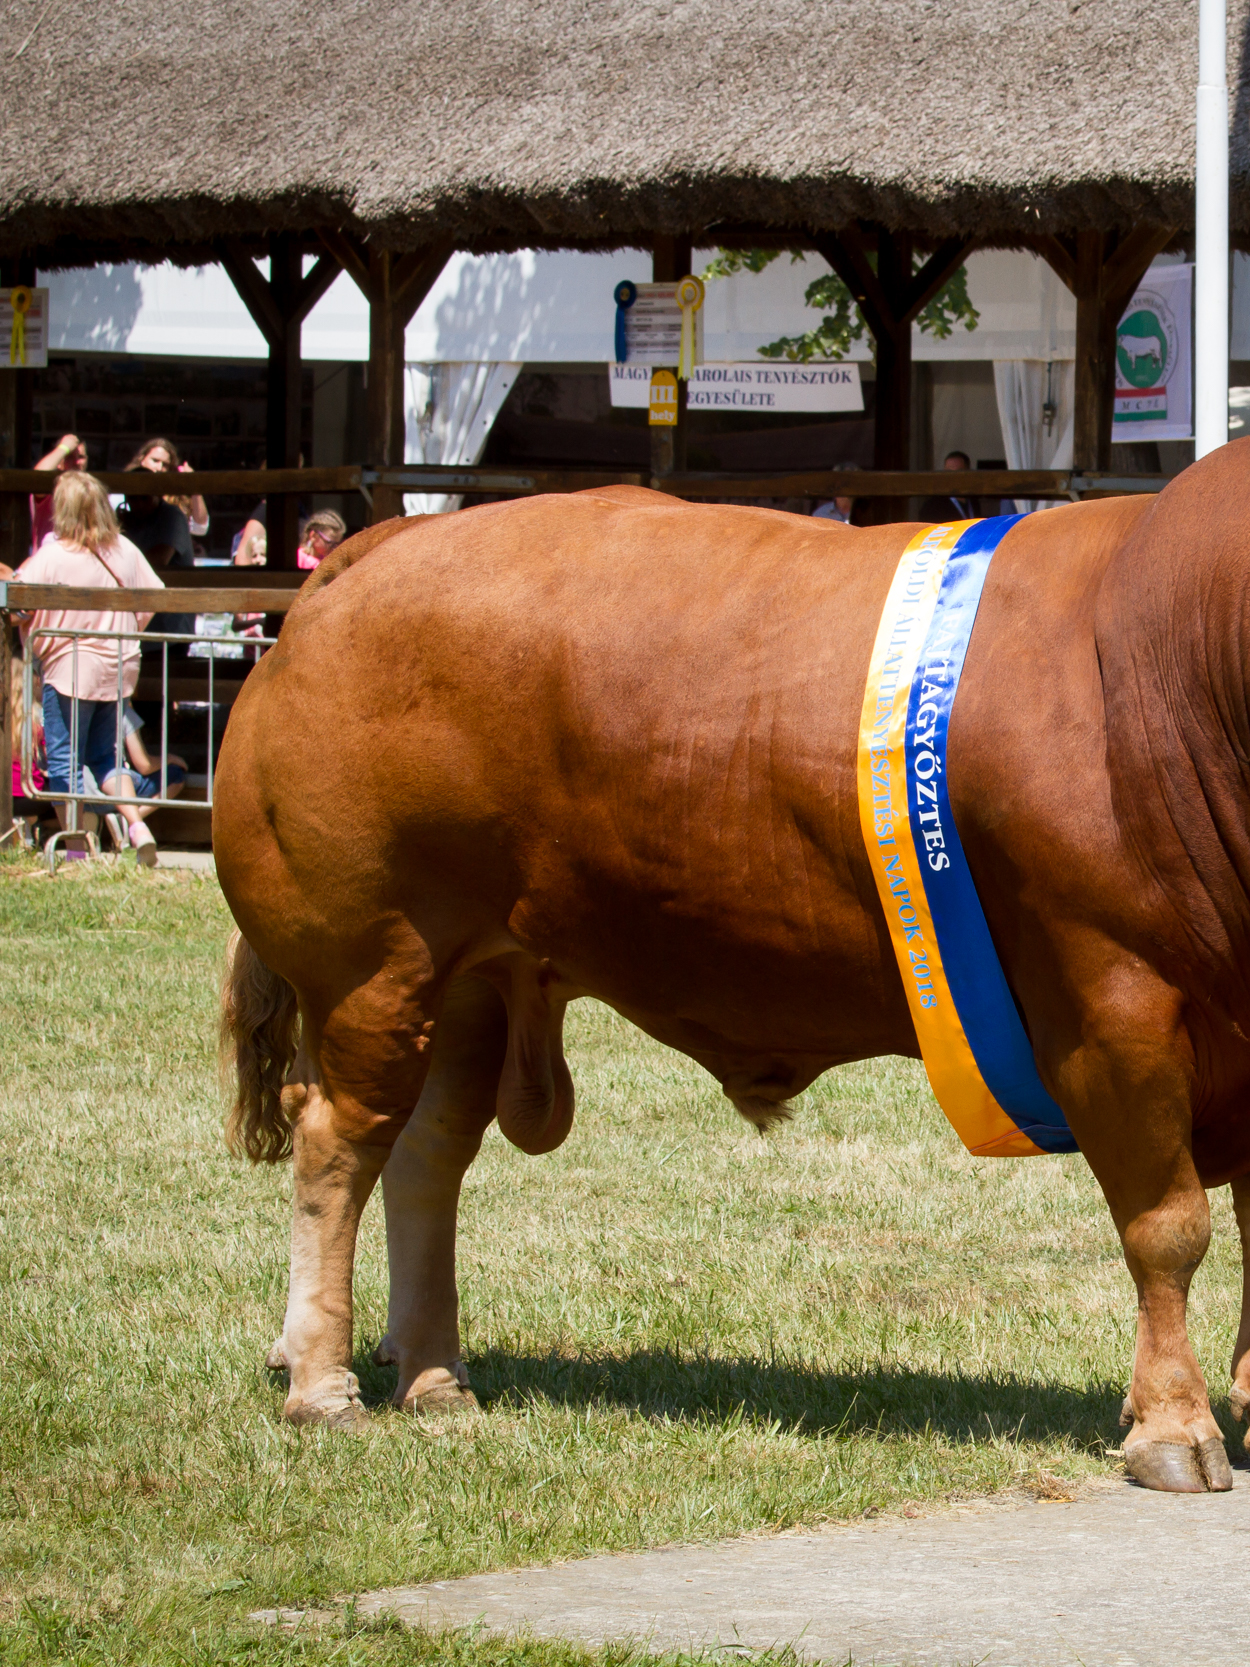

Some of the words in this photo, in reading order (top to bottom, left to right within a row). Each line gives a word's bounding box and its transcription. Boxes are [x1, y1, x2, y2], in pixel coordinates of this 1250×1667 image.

[613, 367, 652, 380] MAGY
[688, 368, 752, 383] AROLAIS
[755, 368, 853, 384] TENYÉSZTŐK
[650, 410, 675, 422] hely
[902, 526, 954, 604] ALFÖLDI
[913, 610, 963, 872] FAJTAGYŐZTES
[882, 854, 924, 944] NAPOK
[908, 949, 938, 1009] 2018
